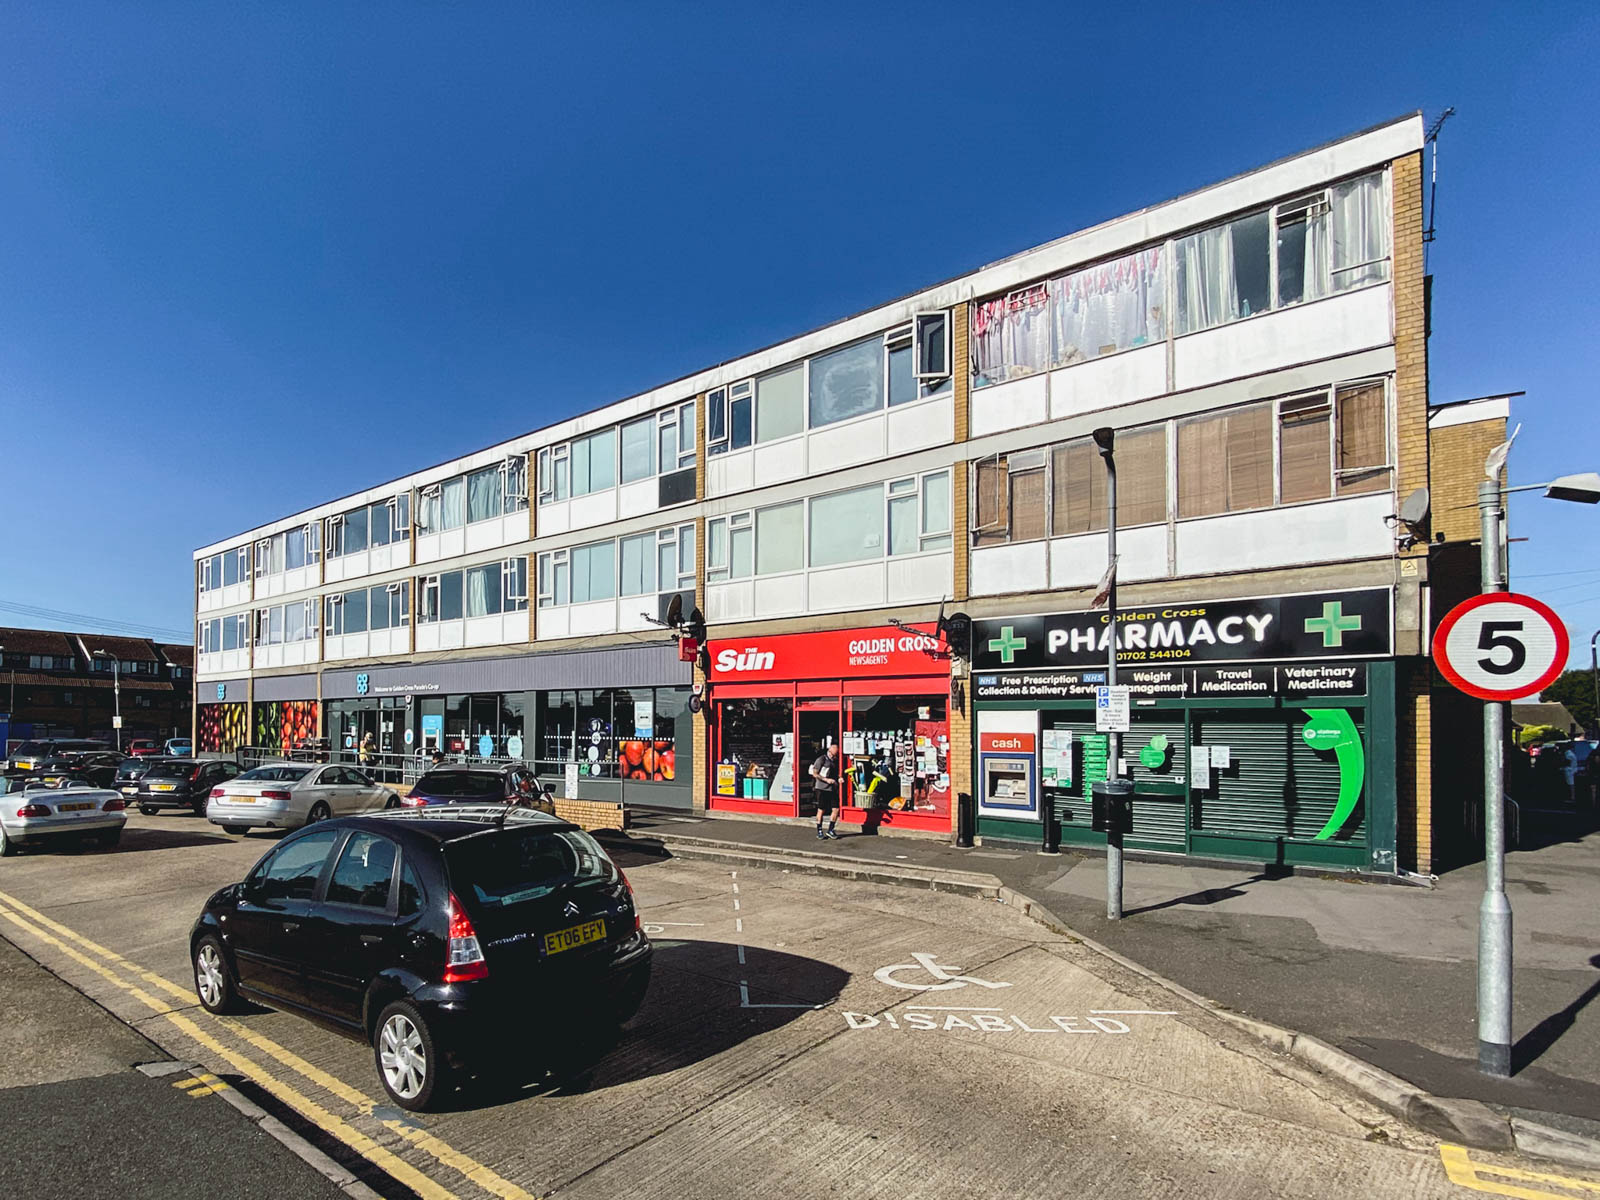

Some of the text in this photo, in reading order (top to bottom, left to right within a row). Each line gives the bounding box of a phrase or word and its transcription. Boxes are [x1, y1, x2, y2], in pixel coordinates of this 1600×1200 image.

[1162, 608, 1206, 619] Cross
[1048, 613, 1273, 654] PHARMACY
[848, 635, 939, 655] GOLDEN CROSS
[1477, 621, 1526, 675] 5
[714, 648, 775, 672] Sun
[848, 654, 888, 666] NEWSAGENTS
[1116, 649, 1191, 661] 01702 544104
[1084, 674, 1104, 682] NHS
[1133, 671, 1172, 683] Weight
[1216, 669, 1252, 680] Travel
[1284, 666, 1356, 678] Veterinary
[979, 676, 997, 685] NHS
[1002, 675, 1078, 685] Free Prescription
[1202, 681, 1267, 691] Medication
[1287, 678, 1353, 690] Medicines
[978, 685, 1097, 696] Collection & Delivery Servic
[992, 738, 1021, 749] cash
[547, 929, 580, 951] ET06
[842, 1011, 1131, 1034] DISABLED
